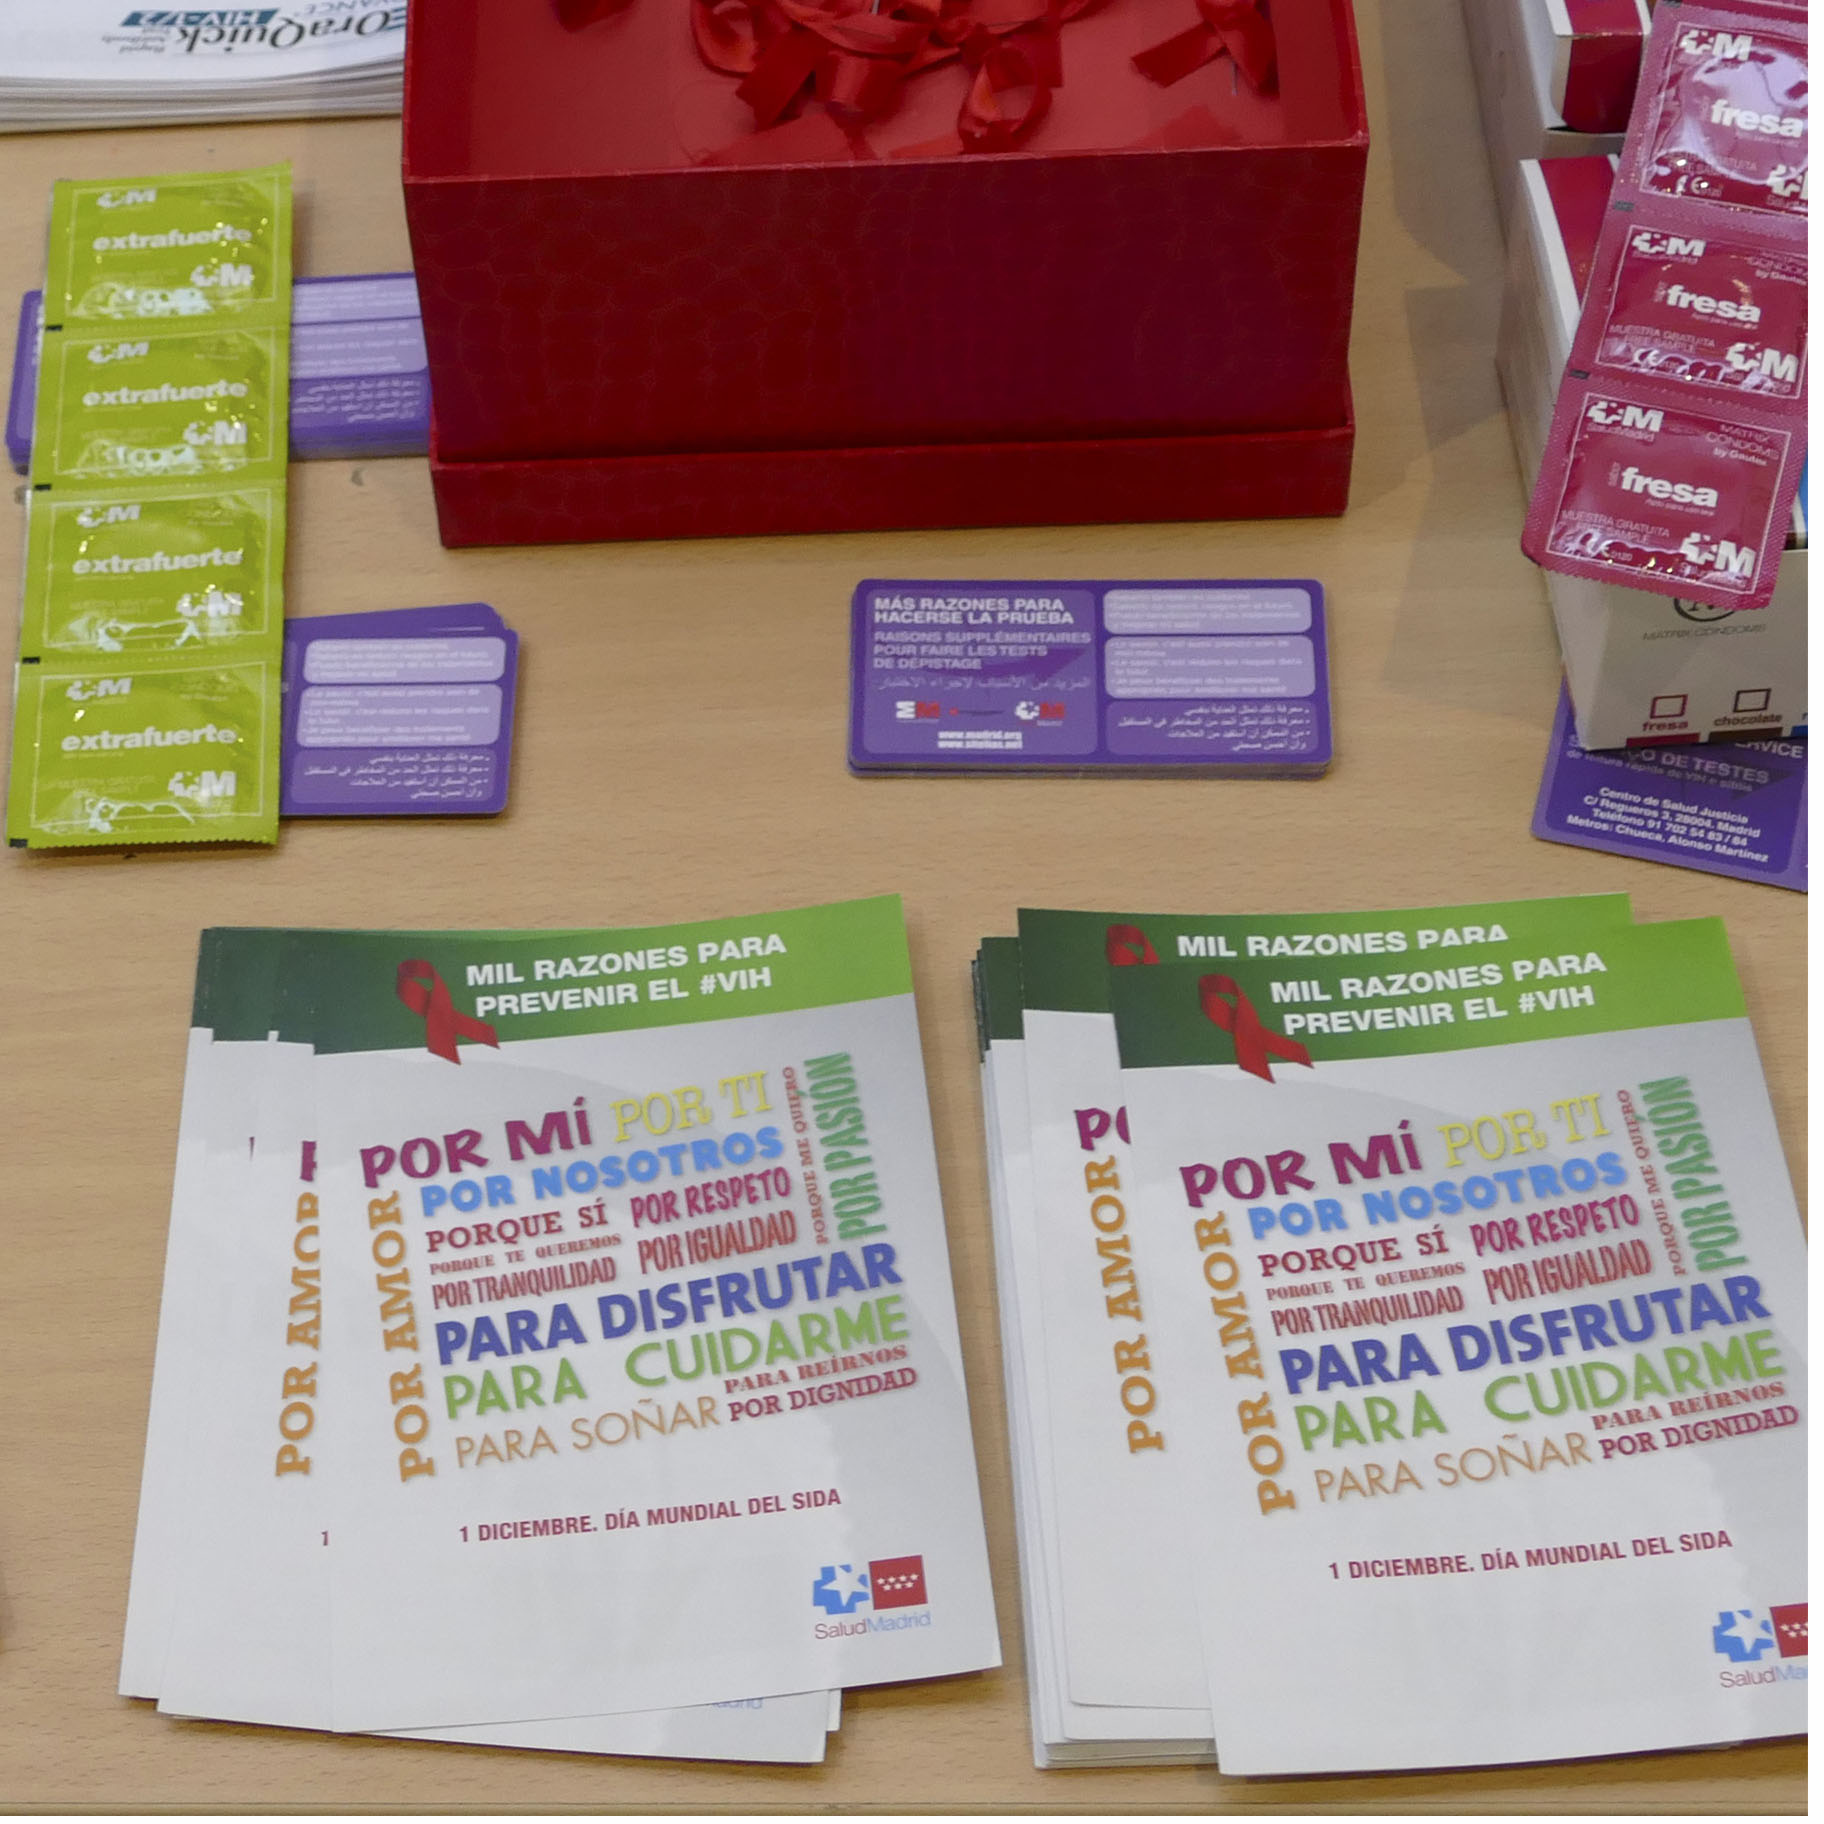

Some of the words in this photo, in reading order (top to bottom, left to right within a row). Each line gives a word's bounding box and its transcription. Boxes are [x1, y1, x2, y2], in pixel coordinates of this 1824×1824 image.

[93, 225, 252, 251] extrafuerte
[1667, 284, 1761, 323] fresa
[1621, 466, 1718, 508] fresa
[875, 595, 915, 610] MÁS
[920, 598, 1009, 611] RAZONES
[1014, 598, 1065, 611] PARA
[467, 963, 525, 986] MIL
[534, 946, 688, 982] RAZONES
[698, 934, 787, 964] PARA
[476, 983, 638, 1017] PREVENIR
[648, 978, 689, 1002] EL
[699, 967, 772, 995] #VIH
[360, 1128, 488, 1188] POR
[505, 1096, 592, 1161] MÍ
[610, 1085, 711, 1143] POR
[719, 1071, 772, 1118] TI
[796, 1052, 872, 1171] PASIÓN
[421, 1175, 515, 1217] POR
[531, 1127, 784, 1200] NOSOTROS
[829, 1171, 887, 1240] POR
[426, 1211, 563, 1253] PORQUE
[579, 1197, 608, 1229] SÍ
[630, 1190, 680, 1227] POR
[684, 1167, 792, 1218] RESPETO
[367, 1190, 420, 1352] AMOR
[432, 1277, 471, 1309] POR
[473, 1256, 617, 1303] TRANQUILIDAD
[637, 1232, 684, 1274] POR
[687, 1210, 798, 1265] IGUALDAD
[435, 1302, 587, 1366] PARA
[598, 1243, 903, 1339] DISFRUTAR
[444, 1357, 587, 1420] PARA
[624, 1294, 909, 1387] CUIDARME
[724, 1370, 790, 1394] PARA
[796, 1344, 908, 1380] REÍRNOS
[389, 1363, 436, 1483] POR
[728, 1396, 784, 1422] POR
[789, 1366, 918, 1412] DIGNIDAD
[455, 1425, 557, 1469] PARA
[570, 1396, 720, 1451] SOÑAR
[459, 1525, 469, 1542] 1
[479, 1515, 598, 1541] DICIEMBRE.
[605, 1508, 640, 1531] DÍA
[647, 1501, 741, 1527] MUNDIAL
[748, 1496, 786, 1515] DEL
[792, 1488, 842, 1510] SIDA
[814, 1612, 931, 1641] SaludMadrid
